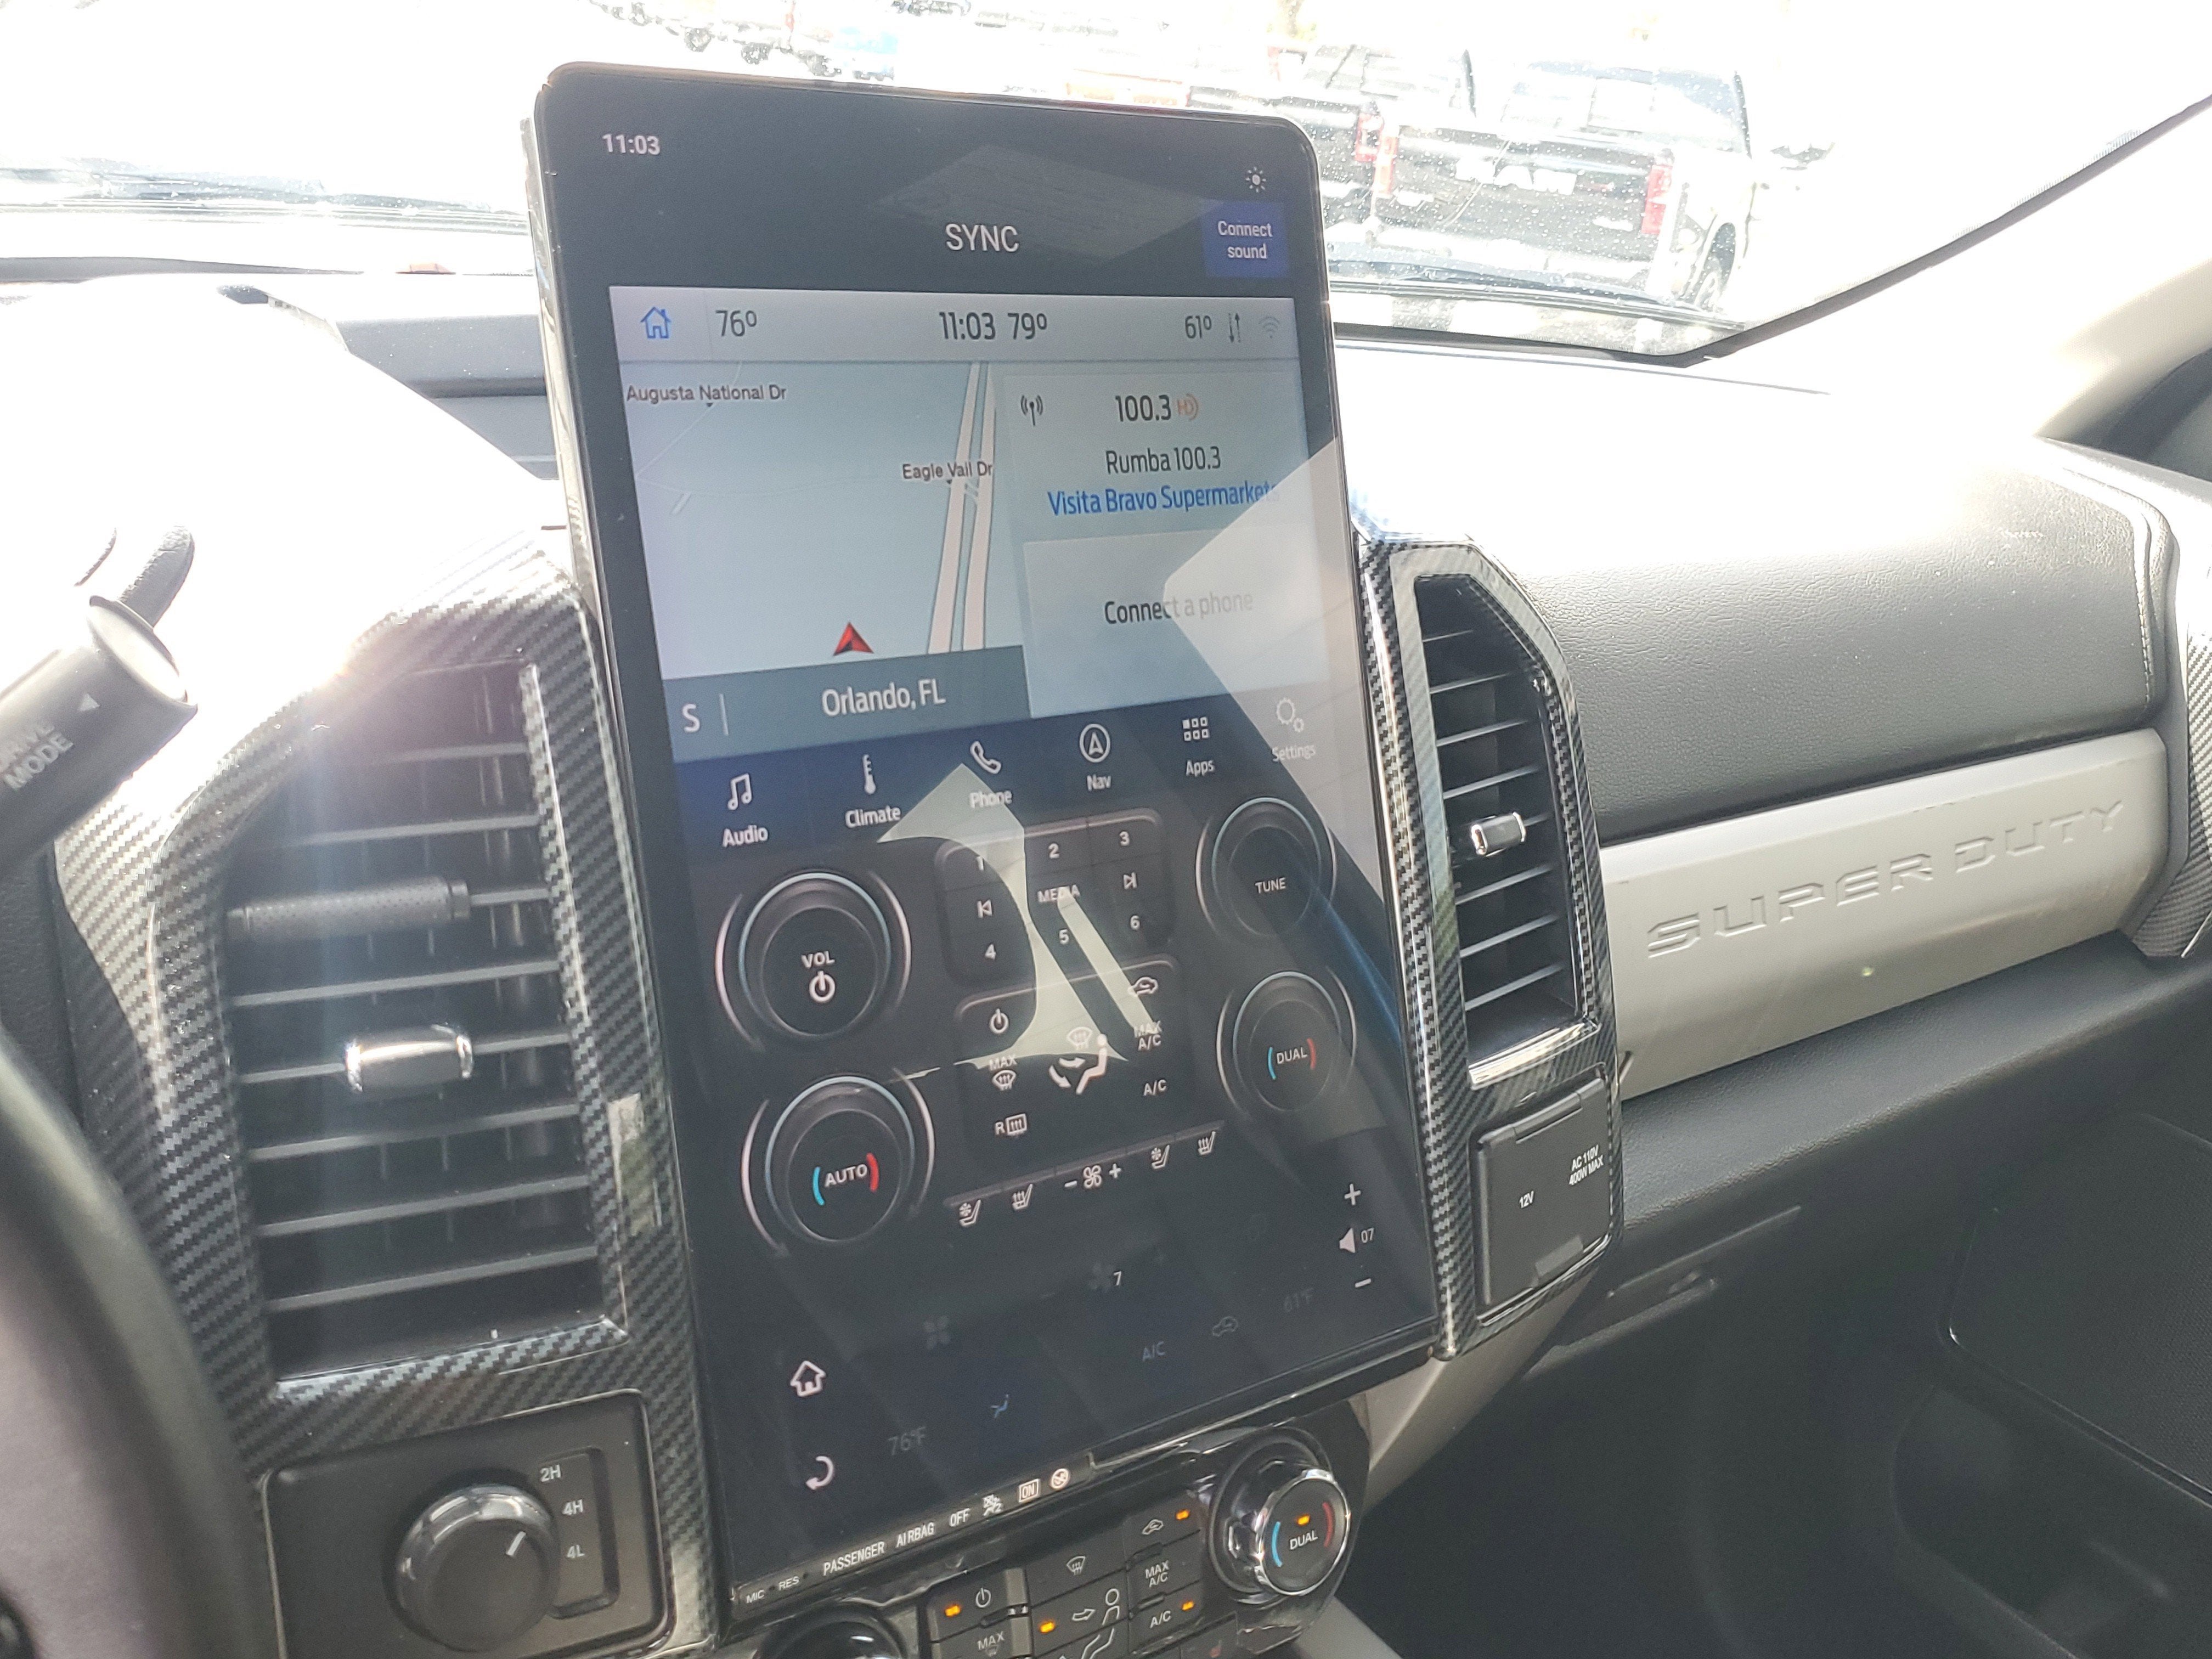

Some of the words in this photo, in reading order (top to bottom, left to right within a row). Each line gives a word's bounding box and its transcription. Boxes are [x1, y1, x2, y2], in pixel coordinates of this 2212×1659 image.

[603, 134, 661, 155] 11:03
[945, 223, 1020, 252] SYNC
[1217, 221, 1273, 238] Connect
[1227, 244, 1268, 259] sound
[939, 312, 996, 340] 11:03
[627, 385, 695, 405] Augusta
[698, 384, 765, 400] National
[769, 385, 787, 399] Dr
[1115, 395, 1172, 422] 100.3
[1105, 449, 1171, 475] Rumba
[1174, 446, 1221, 471] 100.3
[902, 463, 943, 482] Eagle
[977, 461, 994, 476] Dr
[1047, 490, 1102, 516] Visita
[1105, 488, 1158, 514] Bravo
[1104, 599, 1179, 624] Connect
[1183, 600, 1195, 616] a
[1199, 592, 1253, 619] phone
[822, 682, 916, 716] Orlando,
[919, 679, 946, 706] FL
[682, 704, 701, 732] S
[3, 732, 75, 790] MODE
[1272, 742, 1317, 763] Settings
[1186, 759, 1216, 776] Apps
[1087, 774, 1111, 791] Nav
[969, 788, 1012, 808] Phone
[845, 805, 901, 828] Climate
[722, 825, 769, 848] Audio
[1120, 831, 1131, 846] 3
[1048, 843, 1060, 859] 2
[1255, 877, 1286, 894] TUNE
[1647, 853, 1934, 958] SUPER
[1954, 800, 2123, 874] DUTY
[1037, 884, 1081, 904] MEDIA
[1130, 915, 1141, 930] 6
[1059, 929, 1070, 945] 5
[800, 950, 836, 969] VOL
[984, 944, 996, 960] 4
[1133, 1020, 1163, 1038] MAX
[1137, 1035, 1162, 1052] A/C
[989, 1055, 1018, 1072] MAX
[1276, 1047, 1307, 1064] DUAL
[1143, 1079, 1167, 1096] A/C
[1588, 1155, 1604, 1175] MAX
[824, 1163, 868, 1188] AUTO
[1519, 1190, 1534, 1208] 12V
[1361, 1228, 1375, 1243] 07
[1114, 1271, 1123, 1286] 7
[540, 1464, 562, 1482] 2H
[1022, 1485, 1035, 1497] ON
[562, 1499, 584, 1516] 4H
[823, 1541, 885, 1576] PASSENGER
[896, 1522, 935, 1548] AIRBAG
[949, 1508, 970, 1527] OFF
[1289, 1530, 1319, 1550] DUAL
[567, 1545, 585, 1559] 4L
[1145, 1560, 1170, 1580] MAX
[1148, 1572, 1169, 1587] A/C
[746, 1589, 765, 1604] MIC
[778, 1576, 800, 1591] RES
[1150, 1611, 1172, 1628] A/C
[978, 1631, 1005, 1650] MAX
